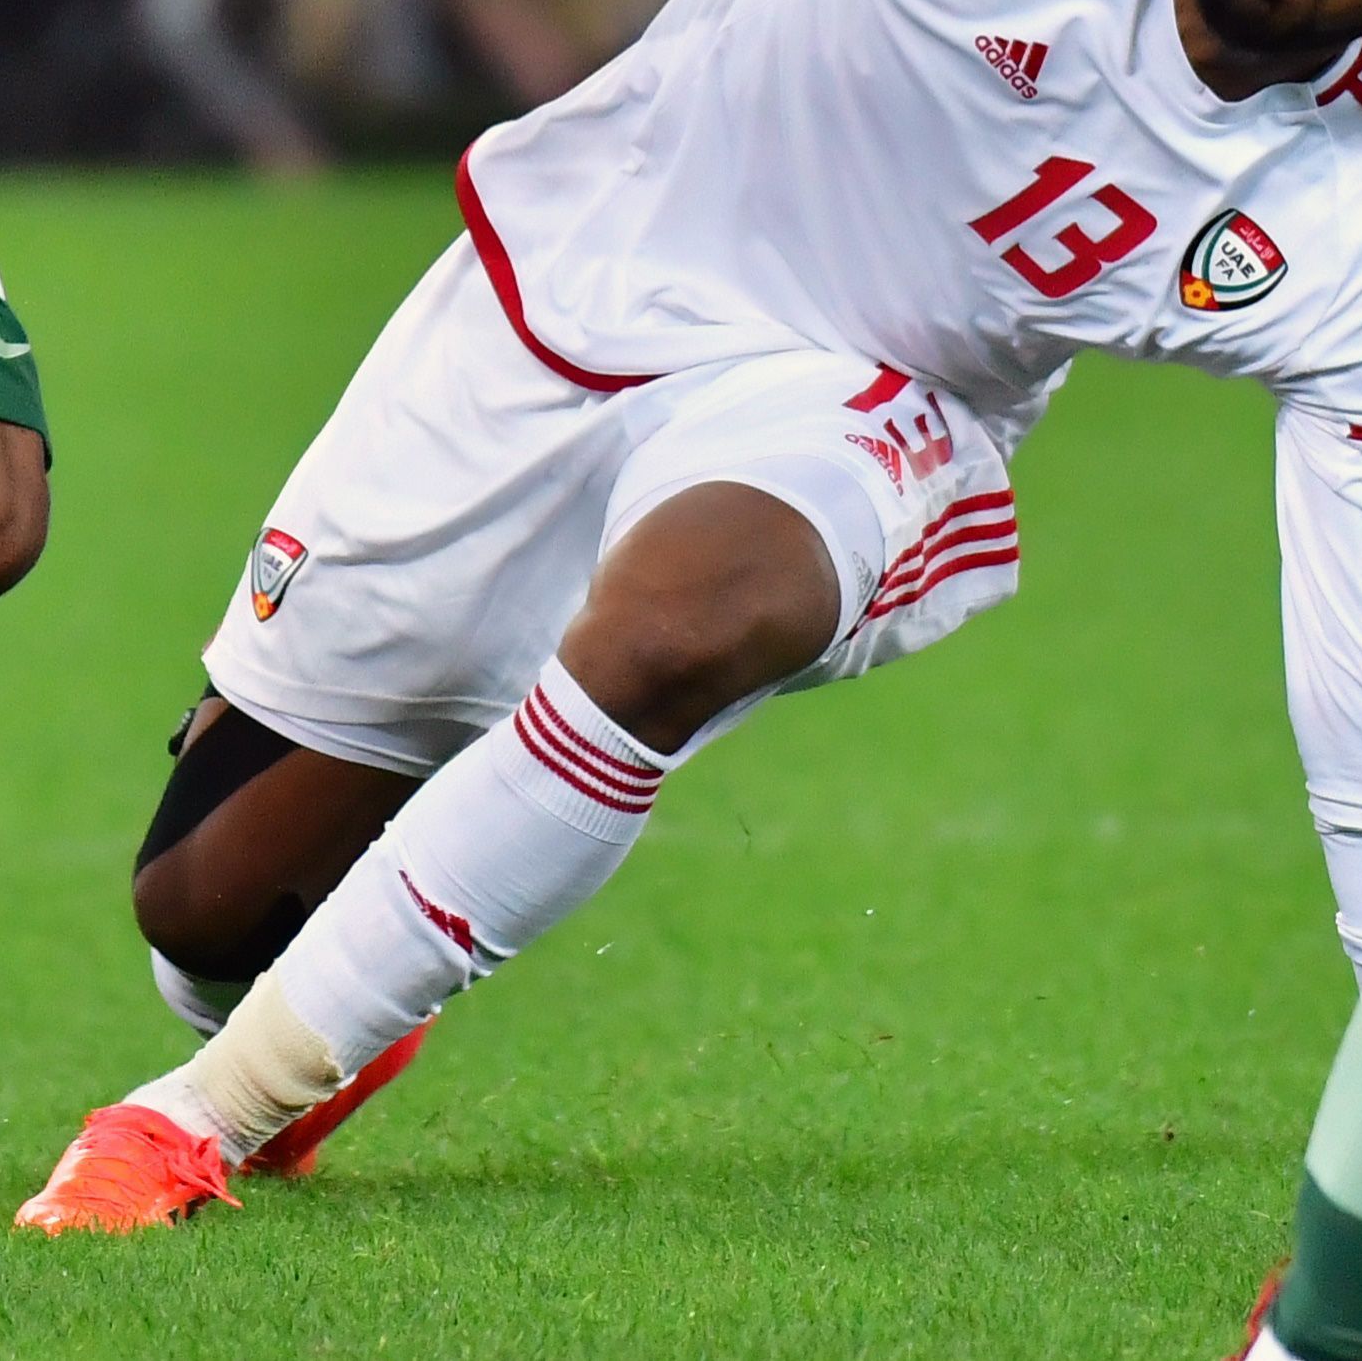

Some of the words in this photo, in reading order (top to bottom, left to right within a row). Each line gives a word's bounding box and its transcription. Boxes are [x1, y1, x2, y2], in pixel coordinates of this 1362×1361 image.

[975, 35, 1038, 99] adidas
[967, 156, 1158, 299] 13
[1215, 259, 1235, 281] FA
[1221, 241, 1256, 279] UAE
[842, 362, 954, 482] 13
[844, 434, 904, 497] adidas
